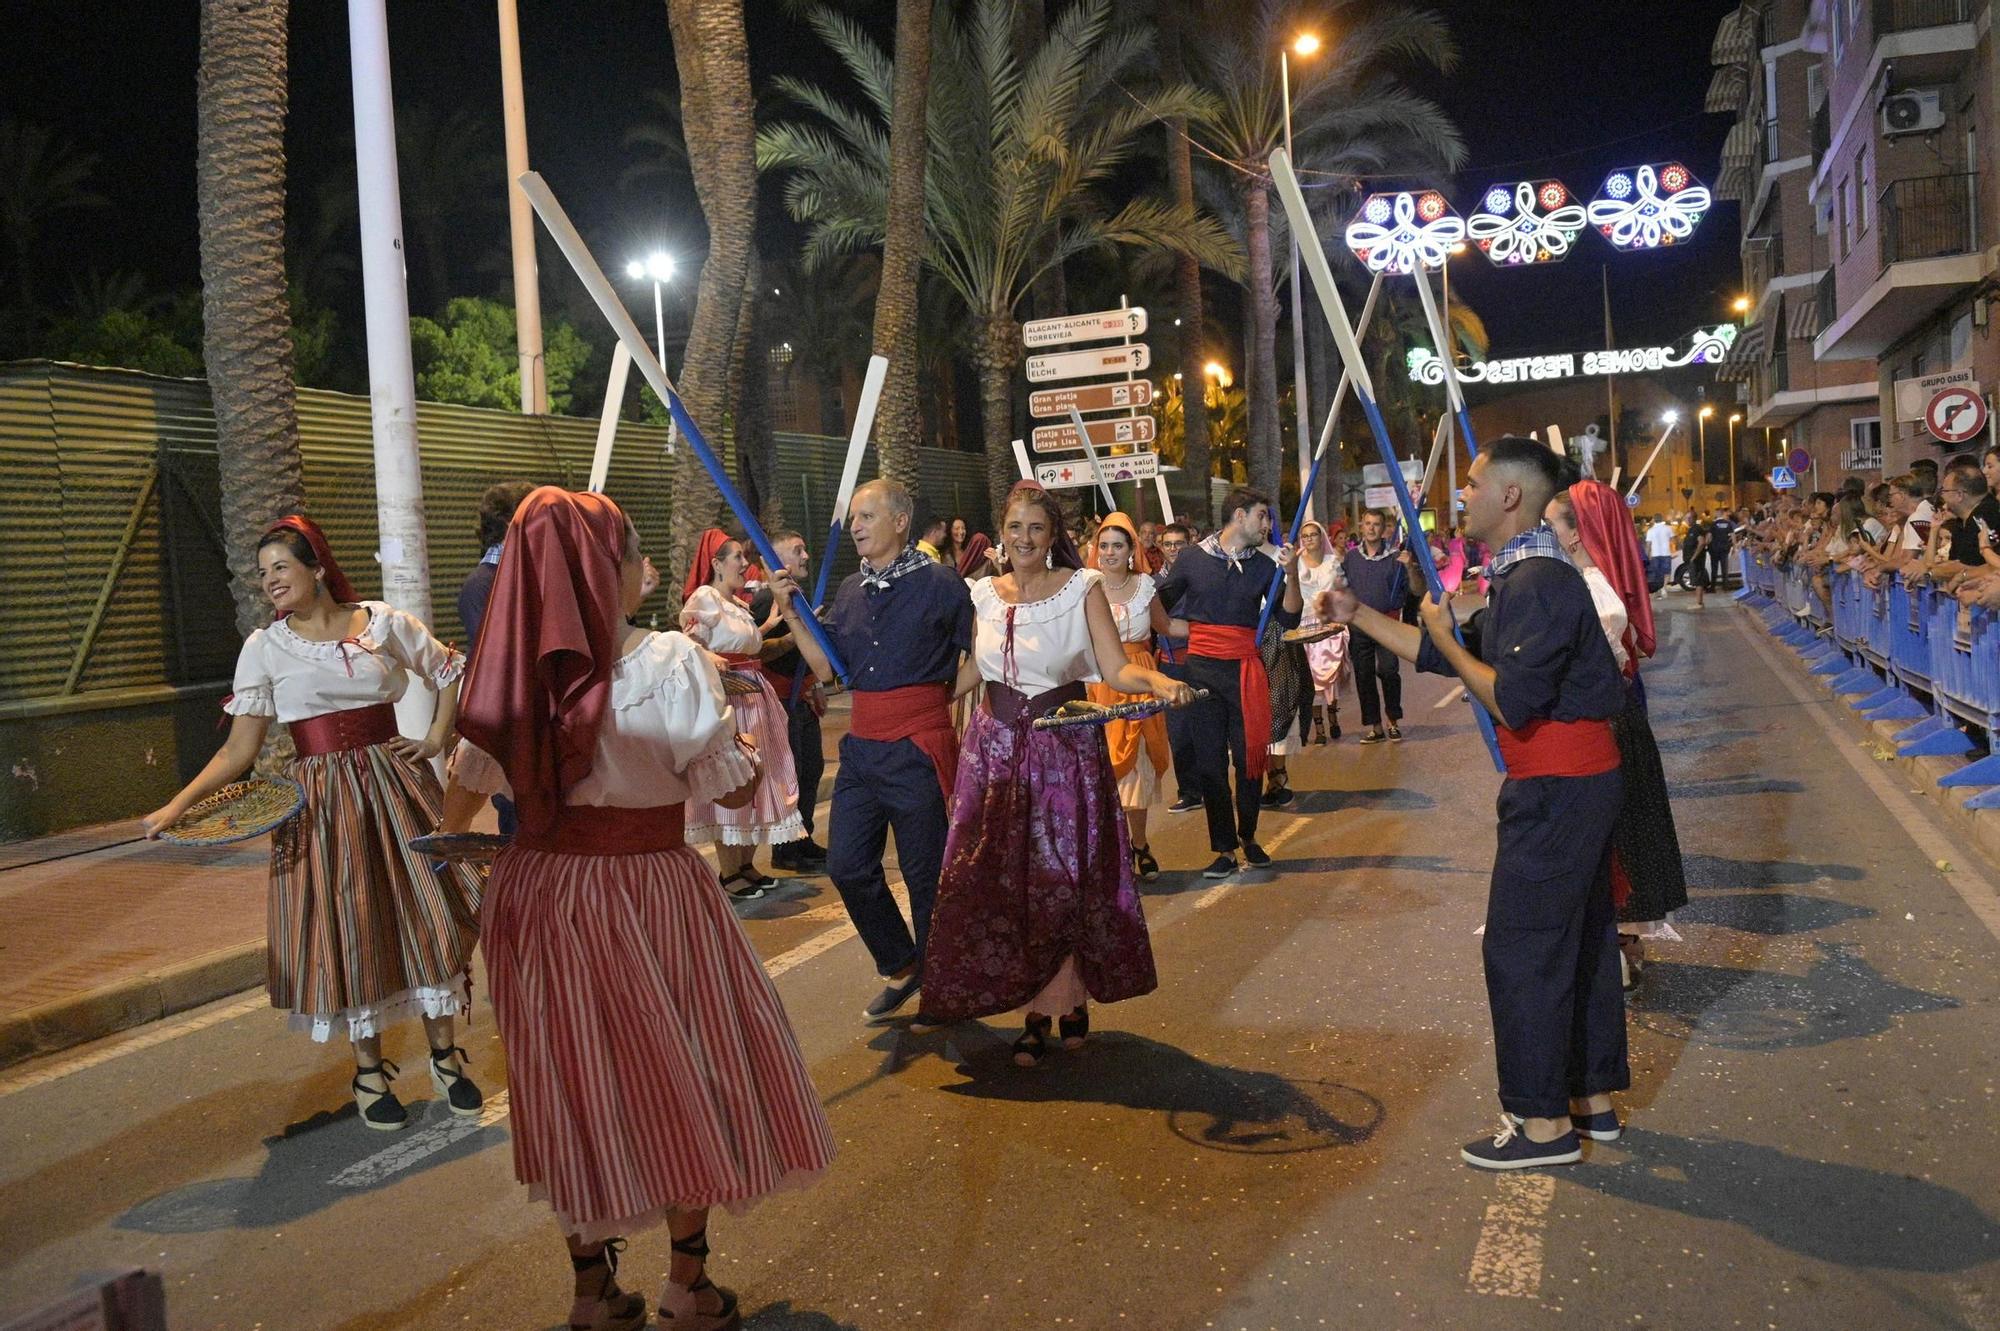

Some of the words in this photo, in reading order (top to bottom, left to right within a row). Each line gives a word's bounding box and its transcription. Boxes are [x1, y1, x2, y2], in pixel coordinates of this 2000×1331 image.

[1027, 331, 1073, 342] TORREVIEJA
[1030, 360, 1046, 369] ELX
[1030, 368, 1057, 378] ELCHE
[1921, 376, 1946, 388] GRUPO
[1947, 372, 1969, 384] OASIS
[1033, 396, 1052, 404] Gran
[1055, 392, 1077, 402] platja
[1033, 404, 1052, 413] Gran
[1036, 430, 1059, 440] platja
[1062, 428, 1077, 436] Llis
[1036, 440, 1058, 449] playa
[1061, 438, 1077, 446] Lisa
[1120, 460, 1130, 468] de
[1134, 458, 1154, 466] salut
[1134, 467, 1155, 475] salud
